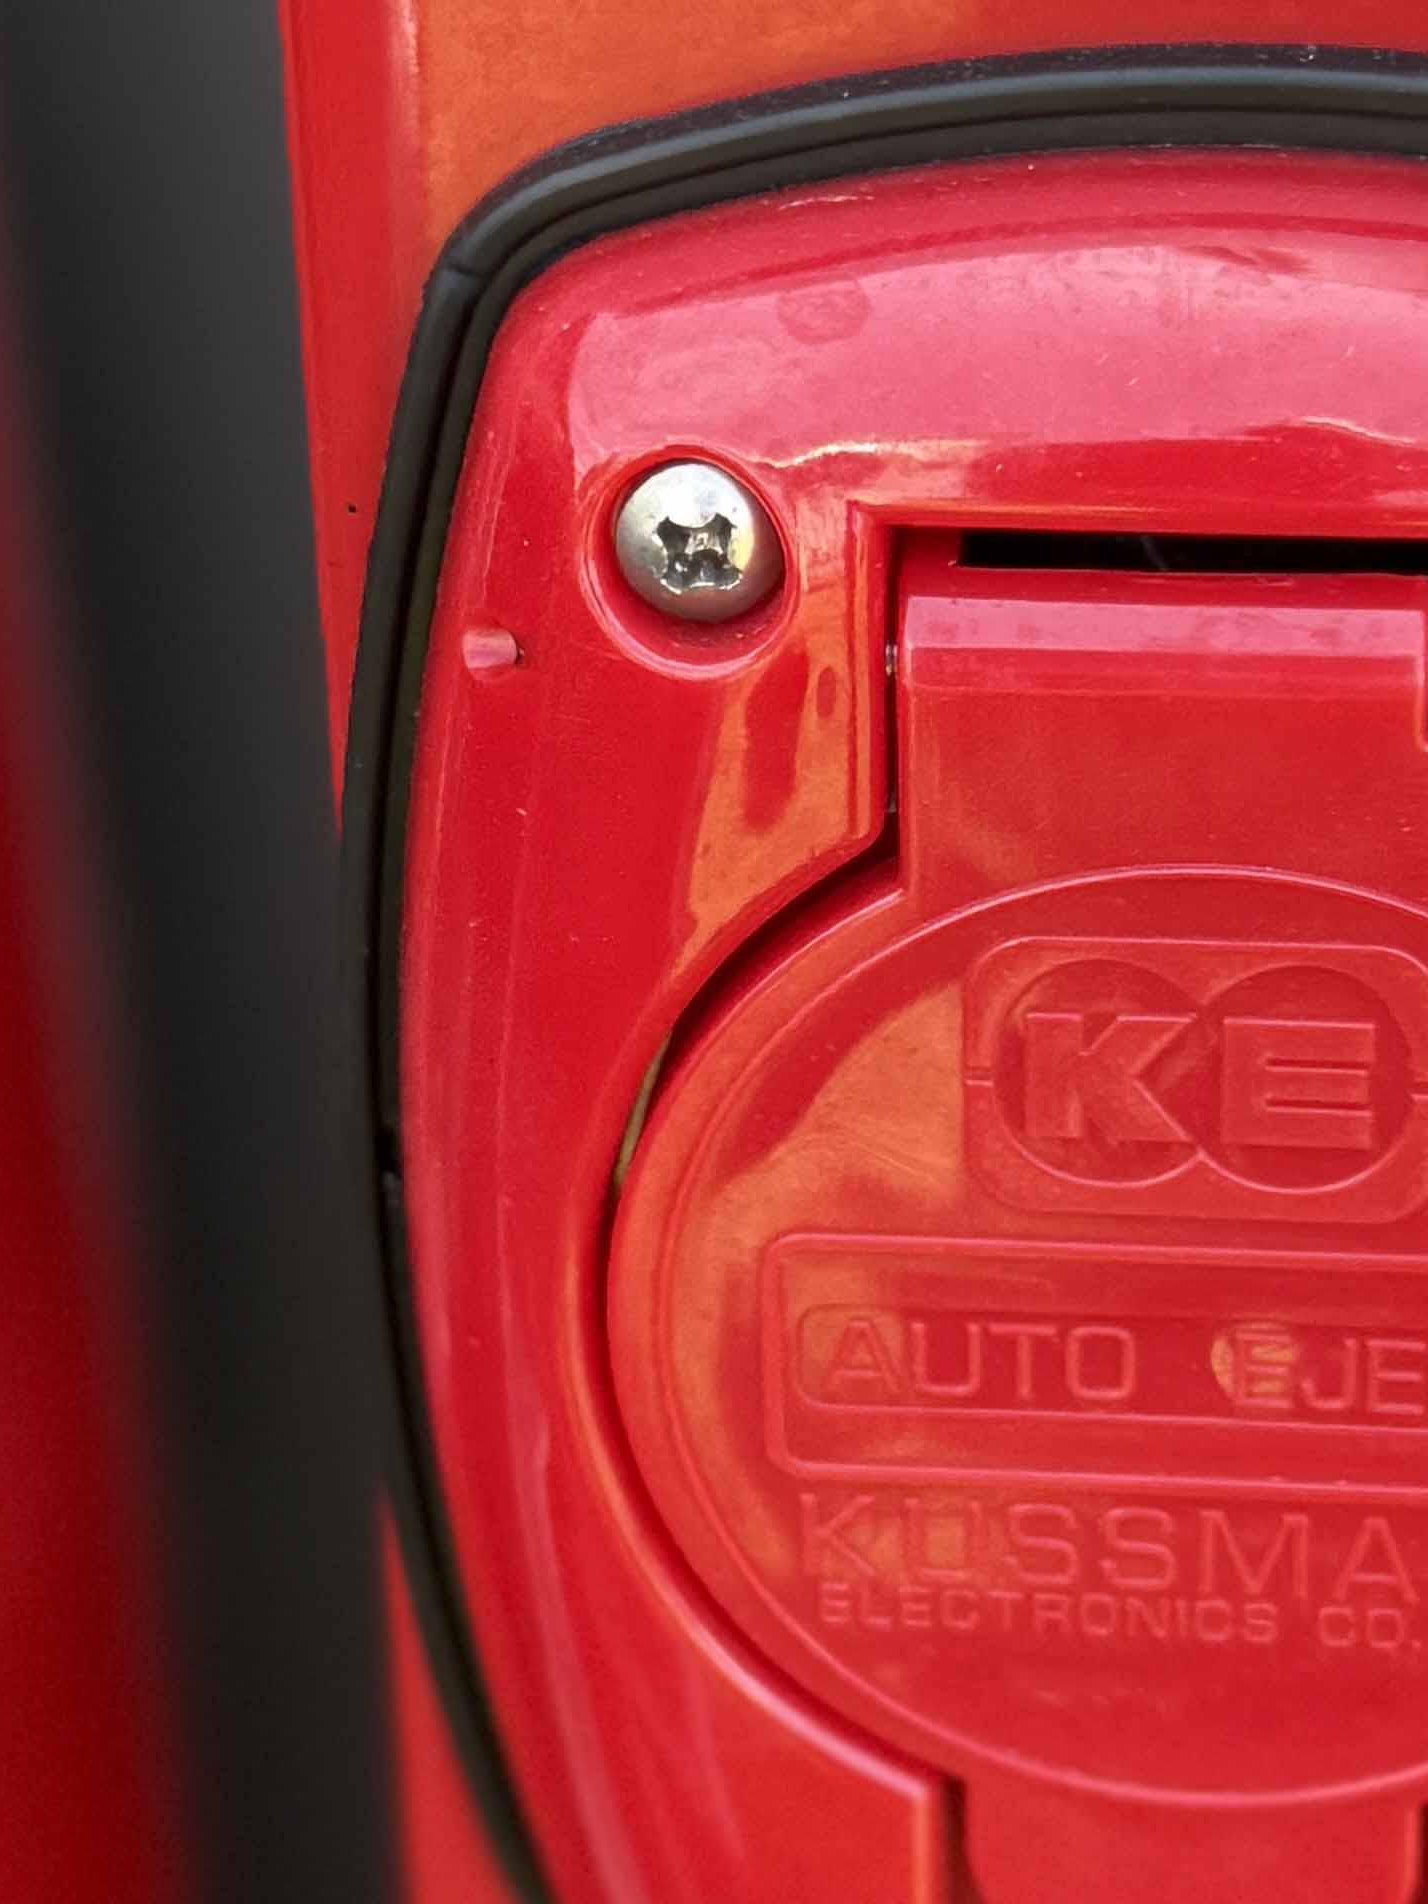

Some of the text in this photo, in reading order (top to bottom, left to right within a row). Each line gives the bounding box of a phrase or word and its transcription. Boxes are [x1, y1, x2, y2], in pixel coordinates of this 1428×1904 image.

[1022, 1008, 1378, 1153] KE
[820, 1314, 1140, 1404] AUTO
[818, 1581, 1280, 1645] ELECTRONICS
